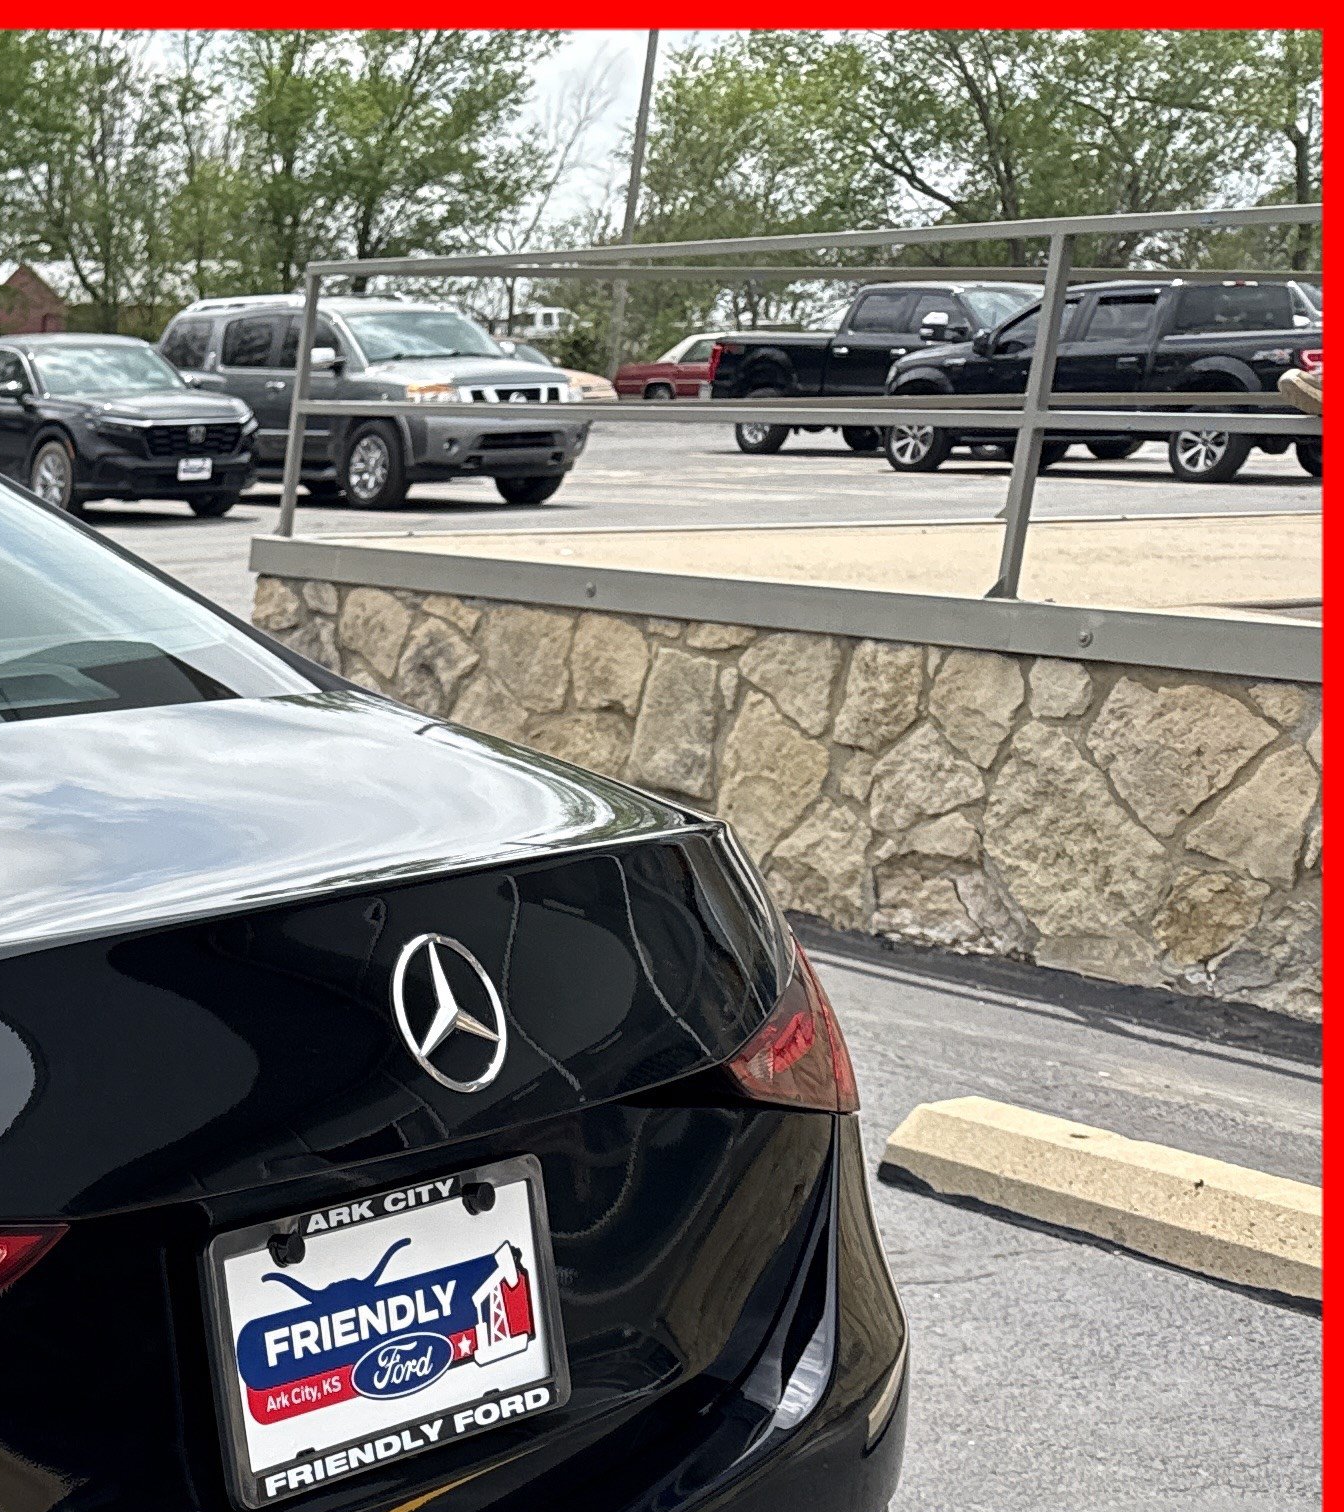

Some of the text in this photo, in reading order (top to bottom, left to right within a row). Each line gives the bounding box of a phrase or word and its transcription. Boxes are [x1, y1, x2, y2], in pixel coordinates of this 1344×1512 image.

[305, 1176, 457, 1235] ARK CITY
[263, 1279, 458, 1368] FRIENDLY
[265, 1375, 343, 1414] Ark City, KS
[372, 1343, 434, 1391] Ford
[264, 1388, 551, 1498] FRIENDLY FORD
